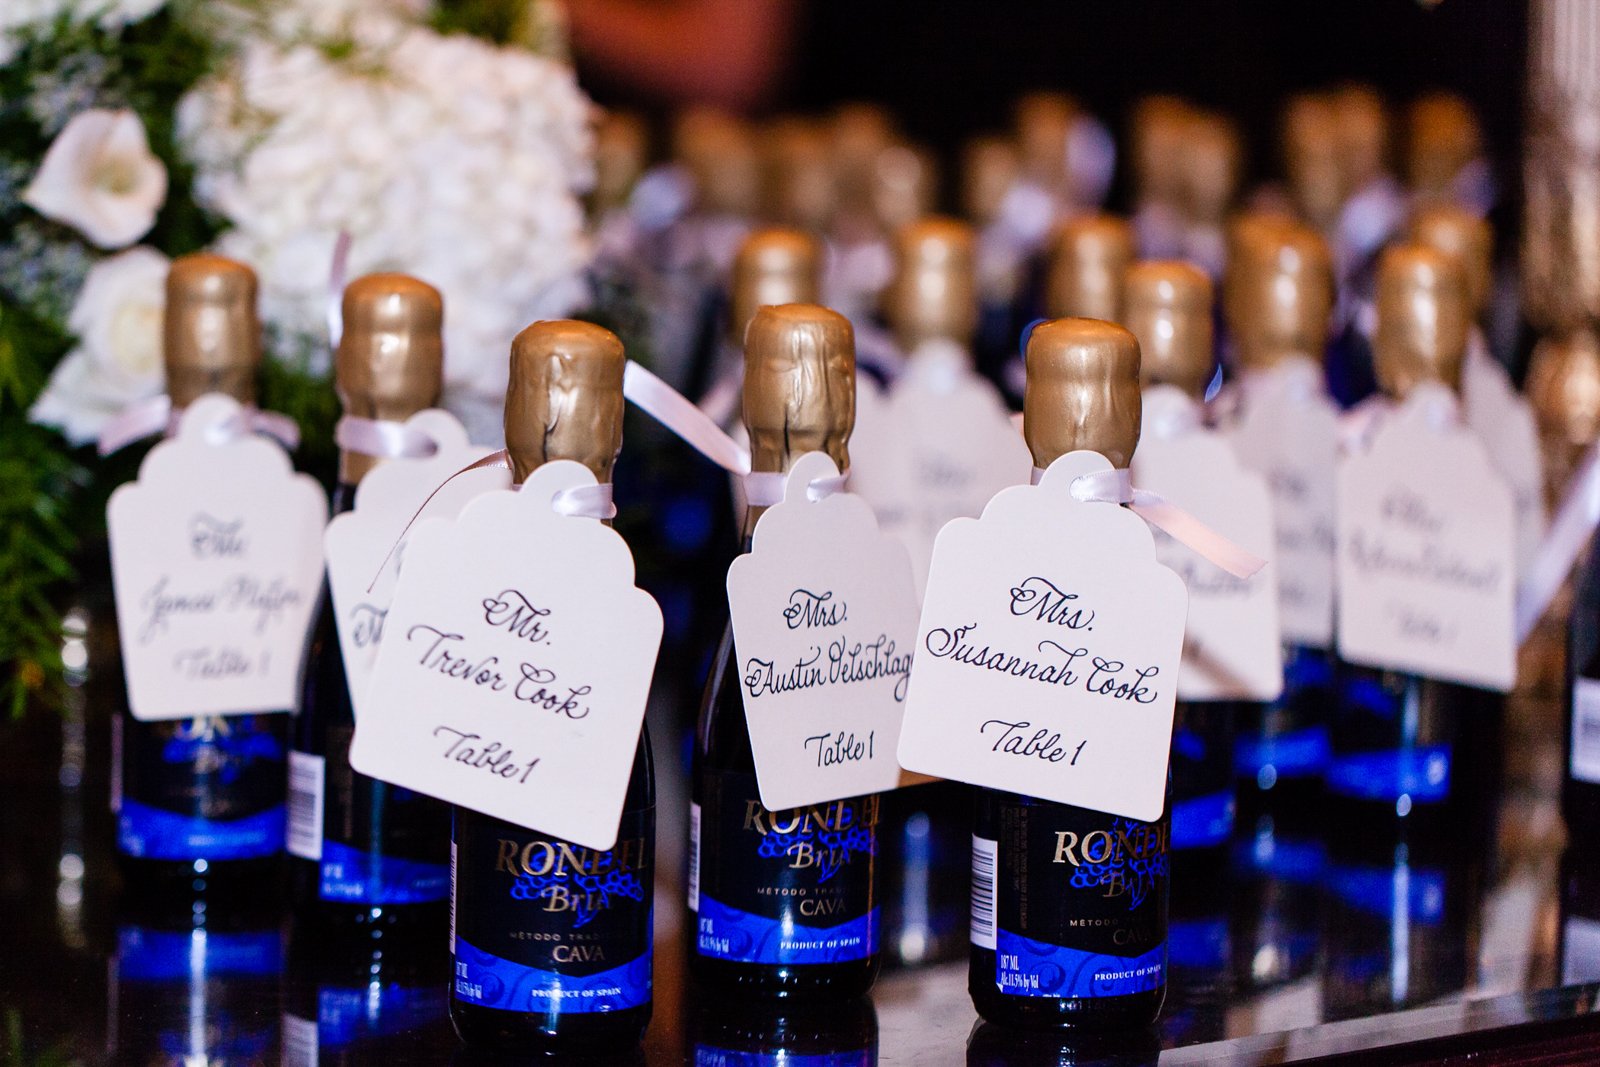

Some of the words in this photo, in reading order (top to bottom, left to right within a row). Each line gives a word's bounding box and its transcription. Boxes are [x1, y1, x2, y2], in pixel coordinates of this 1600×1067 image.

[483, 589, 551, 645] Mr.
[783, 588, 848, 629] Mrs.
[1009, 576, 1095, 632] Mrs.
[407, 624, 507, 691] Trevor
[514, 662, 591, 719] Cook
[745, 646, 827, 697] Austin
[828, 634, 914, 702] Oelschlag
[925, 622, 1089, 687] Susannah
[1085, 656, 1159, 704] Cook
[433, 725, 520, 779] Table
[520, 758, 540, 785] 1
[804, 731, 865, 767] Table
[868, 729, 874, 760] 1
[980, 719, 1067, 763] Table
[1070, 740, 1088, 766] 1
[800, 899, 847, 917] CAVA
[552, 945, 606, 963] CAVA
[780, 940, 824, 951] PRODUCT
[1094, 970, 1135, 981] PRODUCT
[1136, 968, 1146, 977] OF
